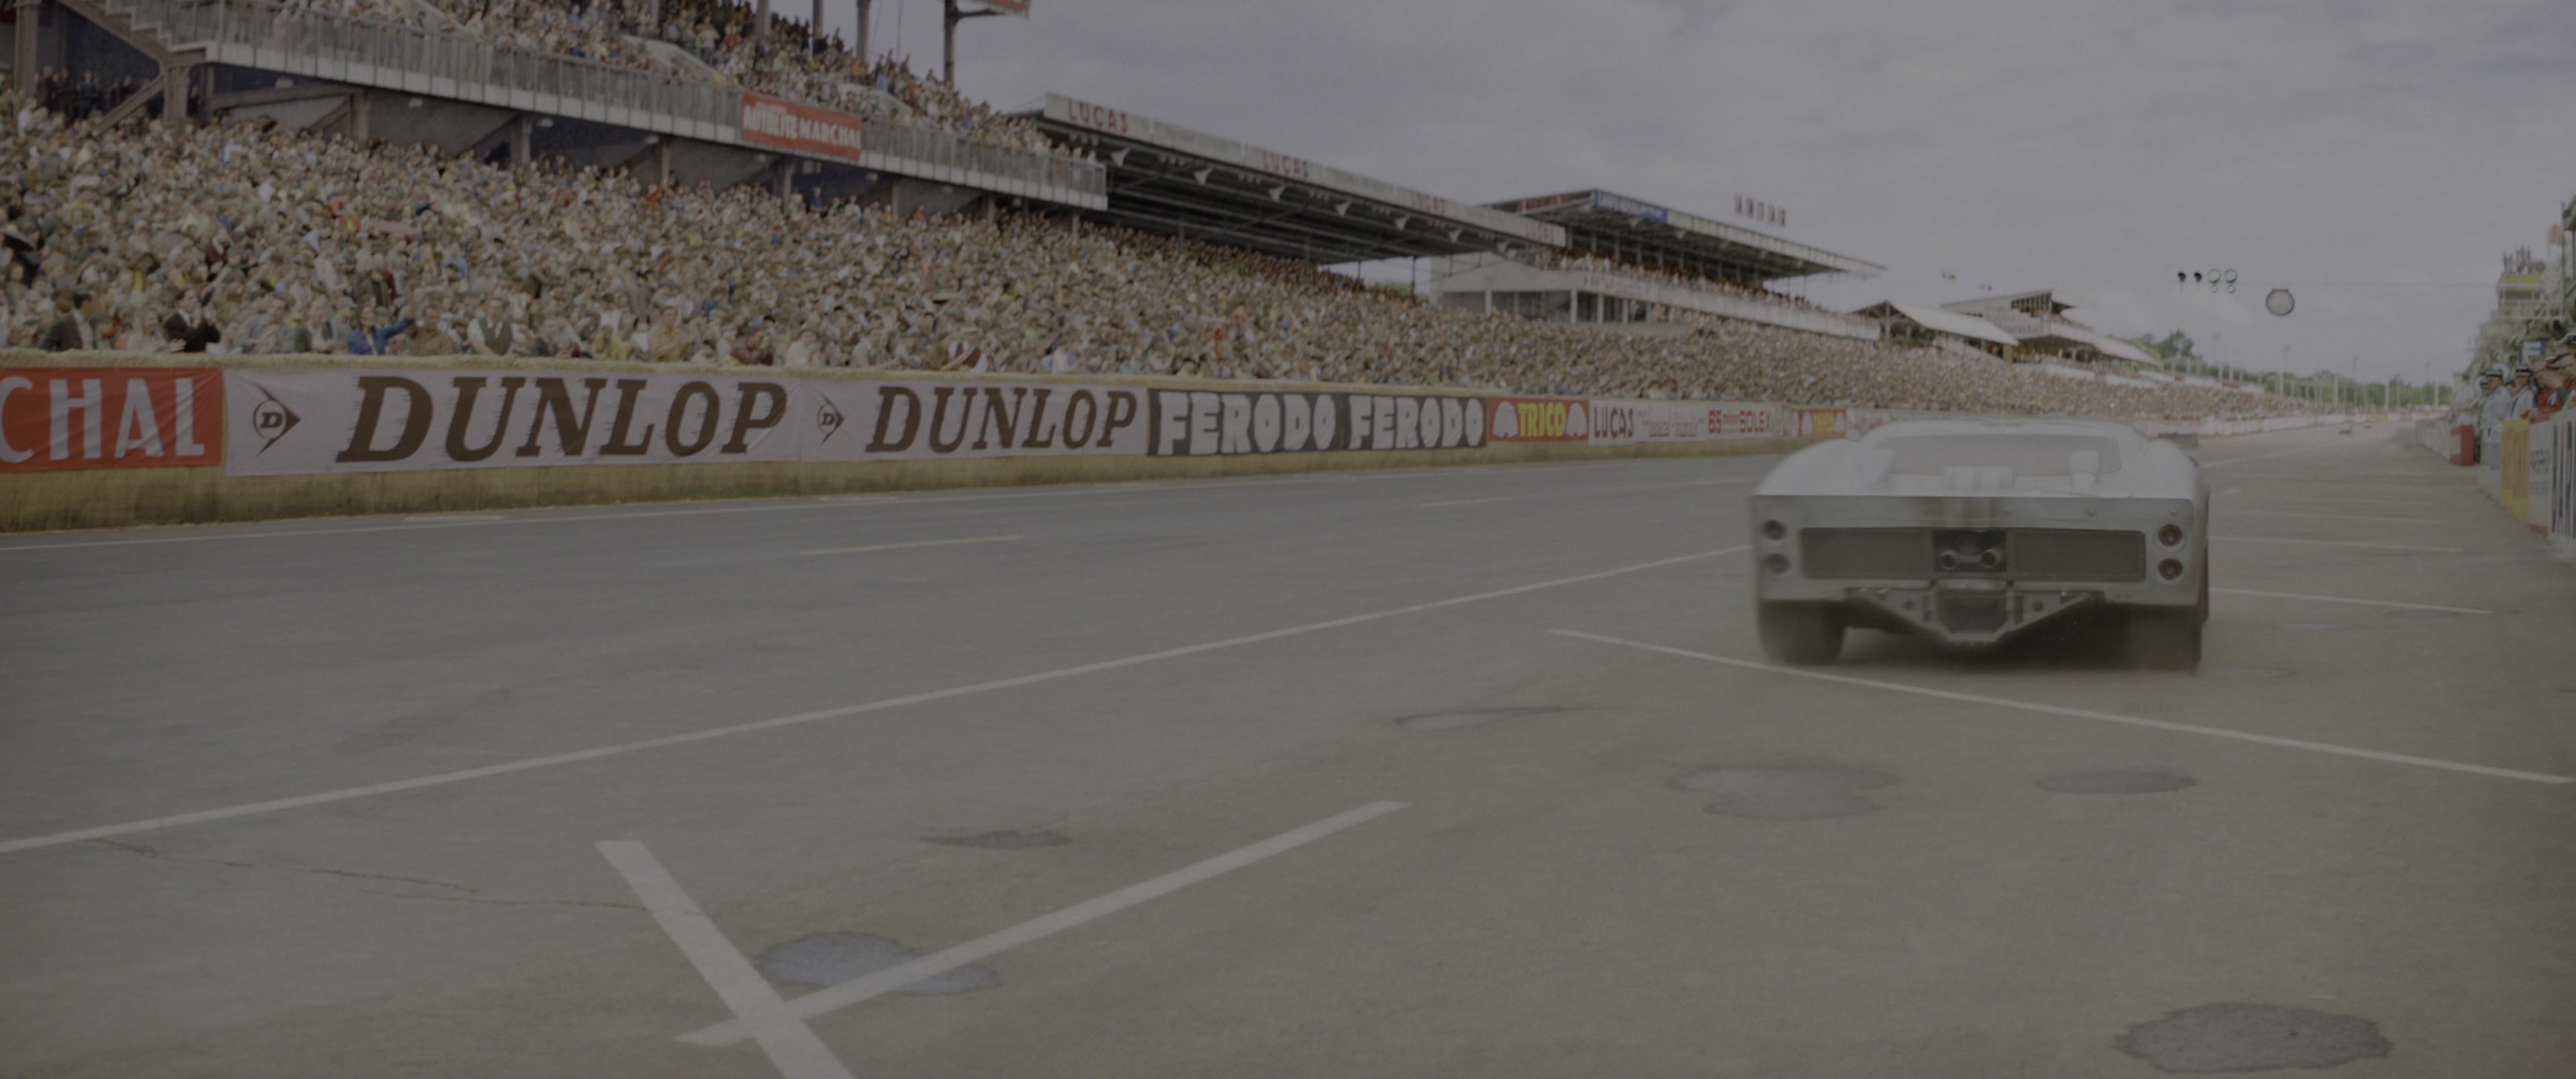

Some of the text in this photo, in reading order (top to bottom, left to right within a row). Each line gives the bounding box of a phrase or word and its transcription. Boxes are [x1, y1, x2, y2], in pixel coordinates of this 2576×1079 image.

[799, 118, 861, 150] MARCHAL
[1068, 99, 1128, 134] LUCAS
[1263, 150, 1309, 179] LUCAS
[335, 376, 788, 463] DUNLOP
[865, 386, 1137, 454] DUNLOP
[1157, 391, 1484, 456] FERODO FERODO
[1517, 401, 1566, 438] TRICO
[1593, 407, 1633, 438] LUCAS
